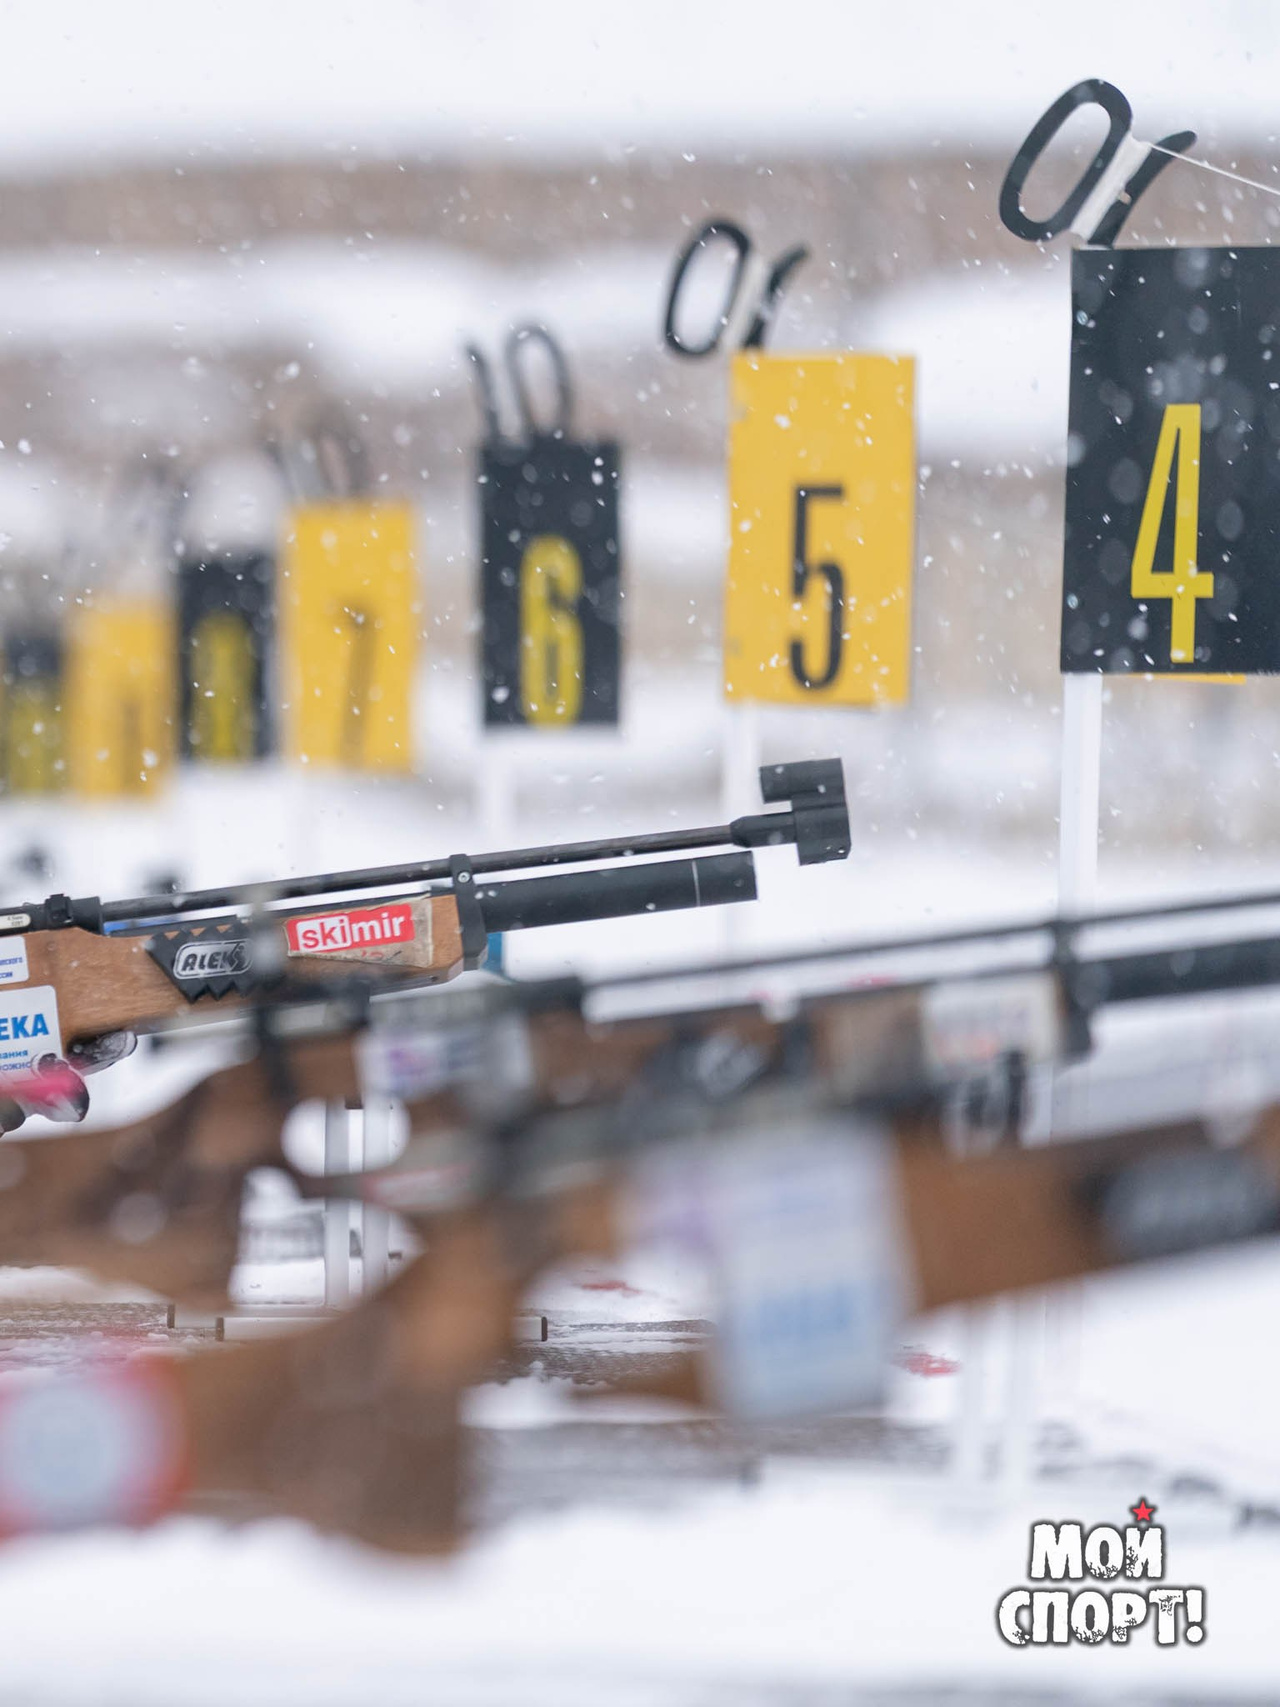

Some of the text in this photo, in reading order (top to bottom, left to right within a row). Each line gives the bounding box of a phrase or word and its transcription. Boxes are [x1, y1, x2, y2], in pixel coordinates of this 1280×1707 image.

[521, 534, 586, 729] 6
[790, 484, 846, 691] 5
[1130, 403, 1215, 663] 4
[300, 910, 406, 949] skimir
